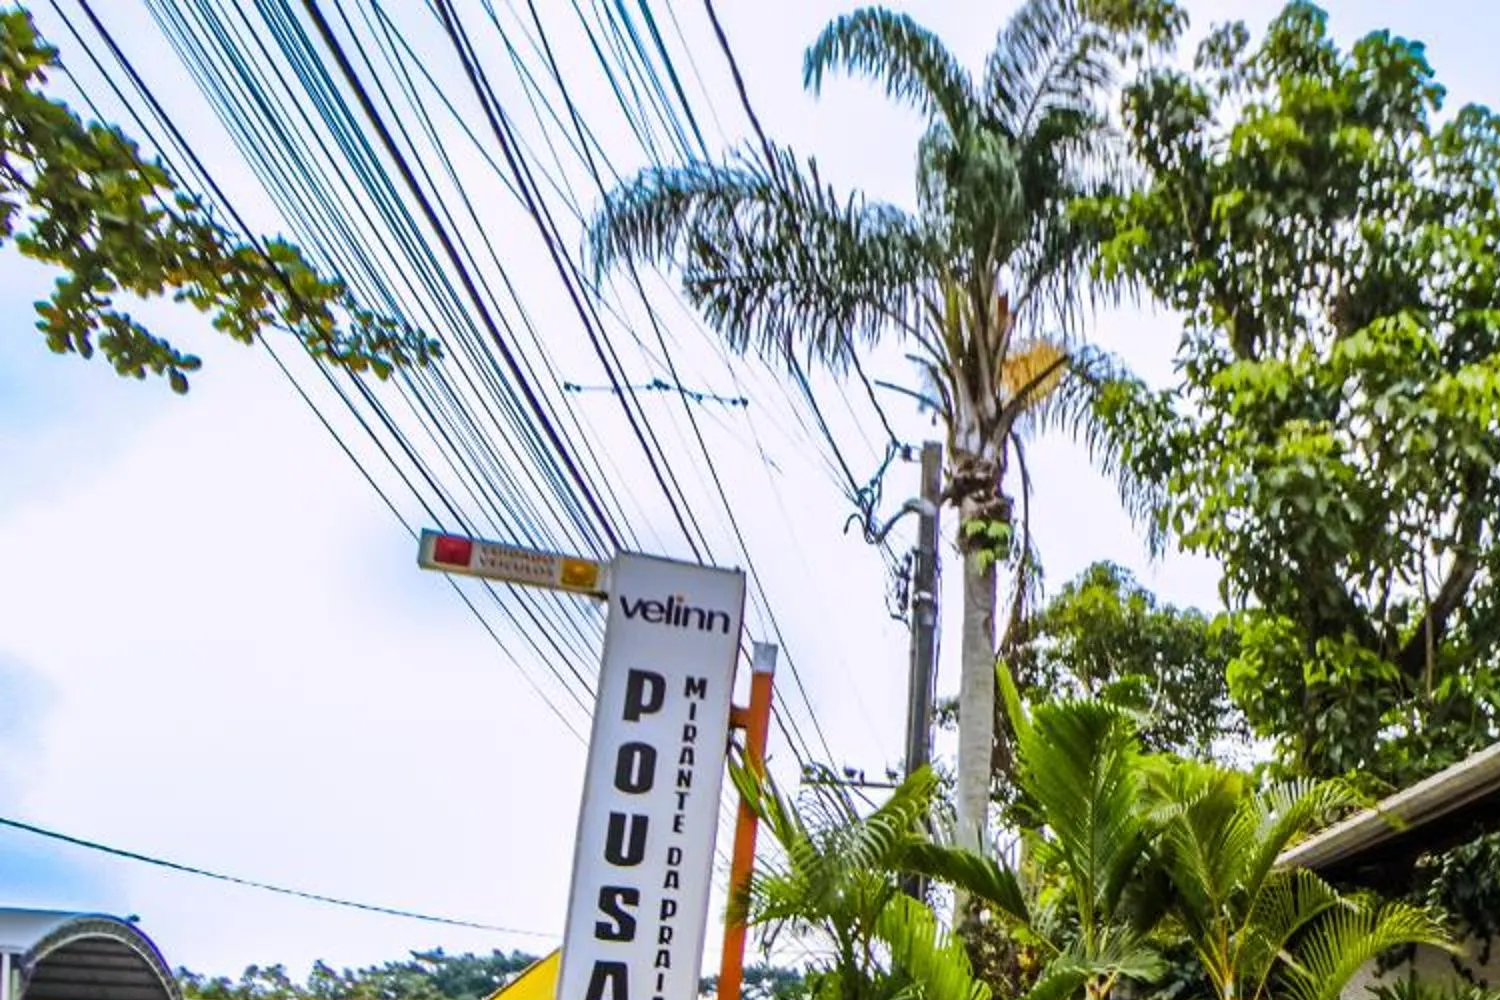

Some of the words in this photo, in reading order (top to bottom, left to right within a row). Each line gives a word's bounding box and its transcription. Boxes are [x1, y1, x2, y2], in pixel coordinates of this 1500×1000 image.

[620, 594, 731, 635] velinn
[672, 675, 708, 834] MIRANTE
[663, 847, 683, 890] DA
